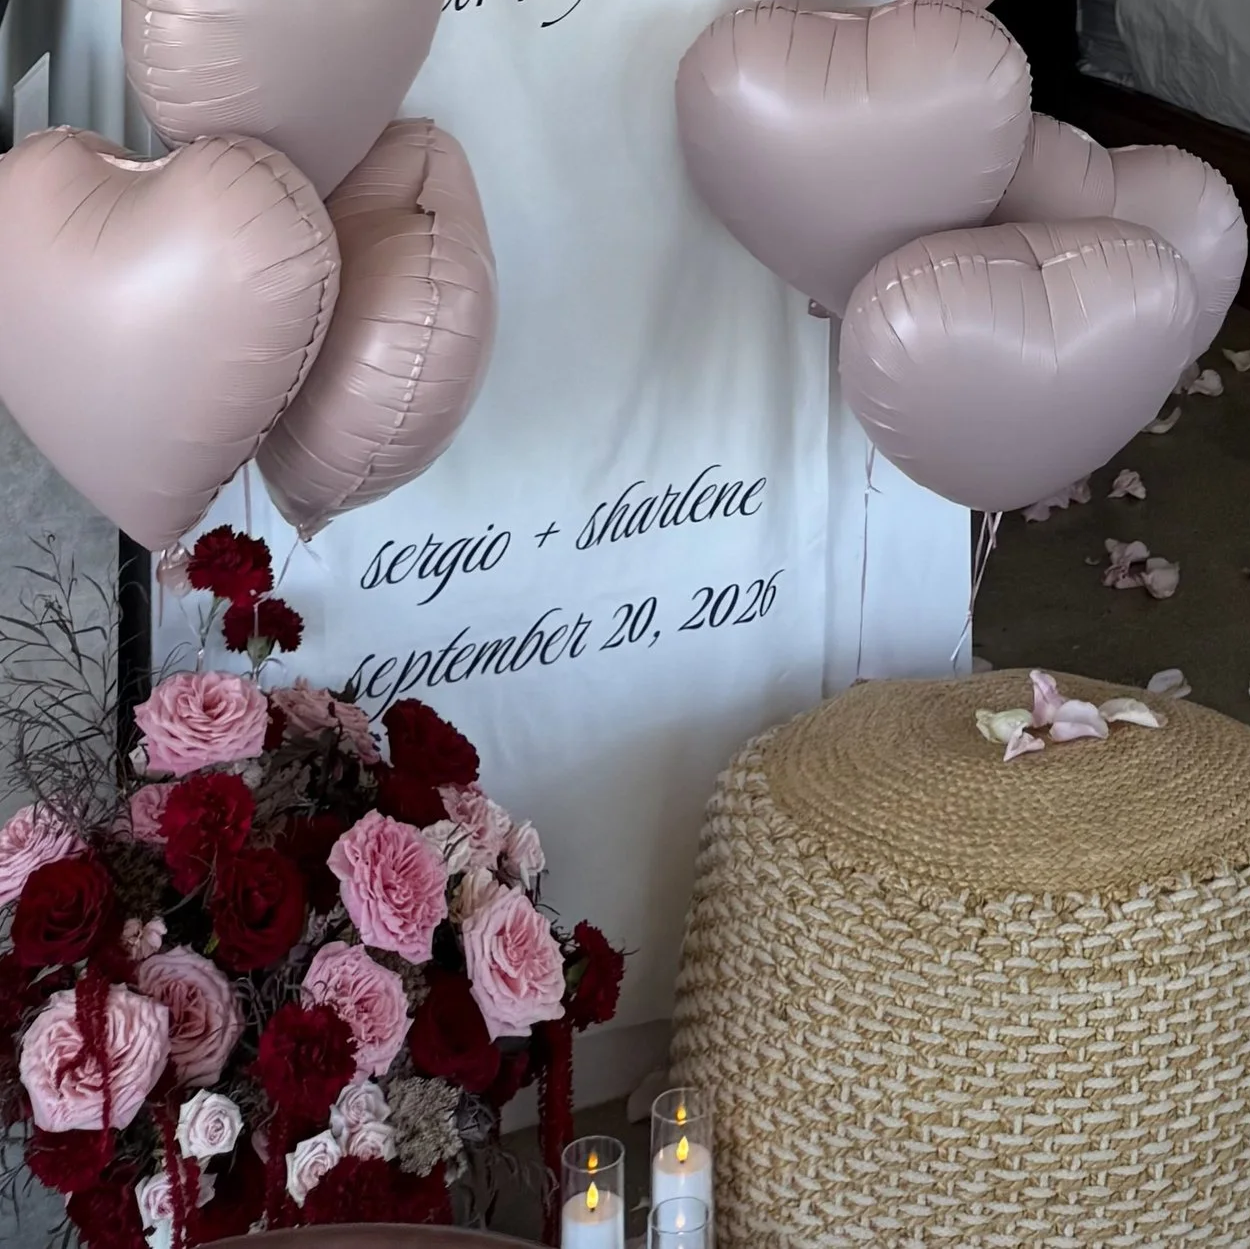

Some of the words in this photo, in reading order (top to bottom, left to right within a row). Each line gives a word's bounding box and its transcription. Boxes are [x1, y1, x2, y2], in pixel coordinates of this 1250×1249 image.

[359, 523, 511, 606] sergio
[534, 521, 560, 549] +
[574, 463, 768, 551] sharlene
[348, 607, 593, 724] september
[599, 596, 662, 651] 20,
[677, 568, 786, 633] 2026
